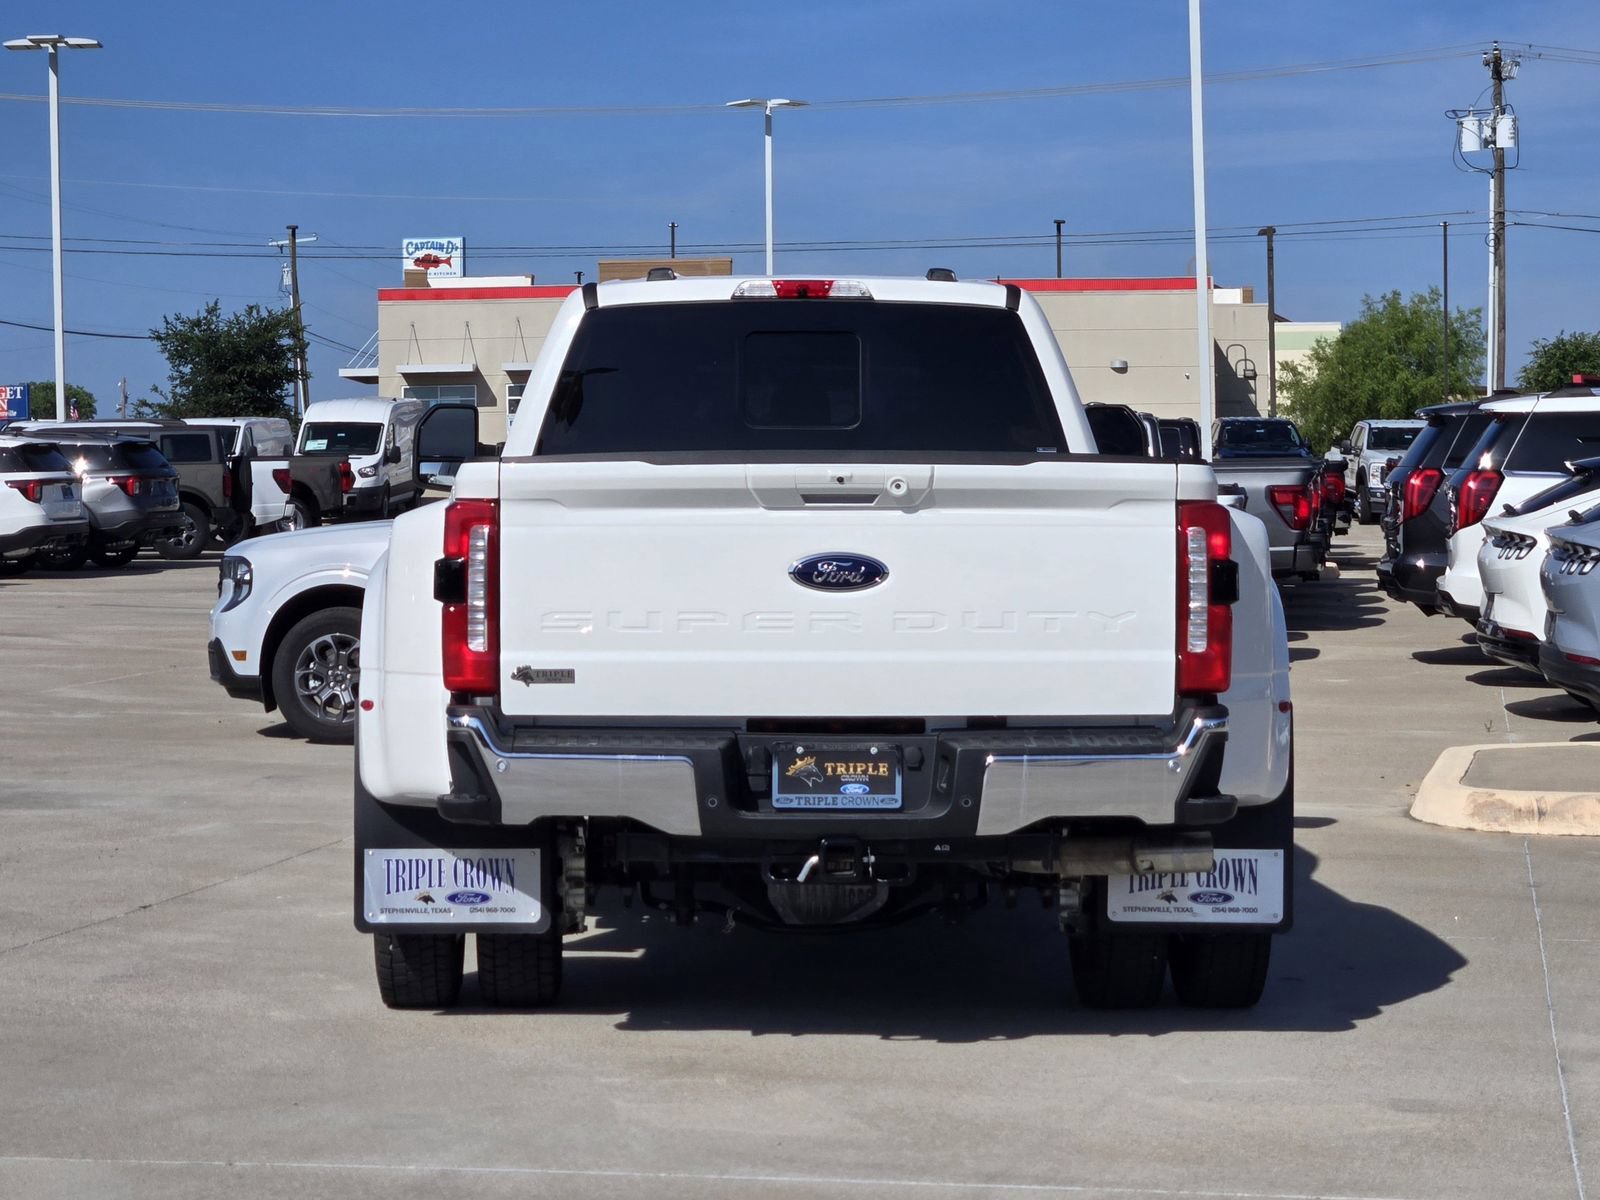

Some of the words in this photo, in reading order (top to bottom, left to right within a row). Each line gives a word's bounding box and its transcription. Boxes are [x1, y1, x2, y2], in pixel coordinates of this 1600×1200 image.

[406, 240, 445, 256] CAPTAIN
[812, 560, 866, 583] Ford
[540, 610, 862, 633] SUPER
[893, 610, 1137, 633] DUTY
[824, 762, 889, 776] TRIPLE
[795, 796, 838, 806] TRIPLE
[840, 796, 880, 807] CROWN
[384, 858, 446, 895] TRIPLE
[453, 857, 516, 894] CROWN
[1174, 906, 1194, 914] TEXAS
